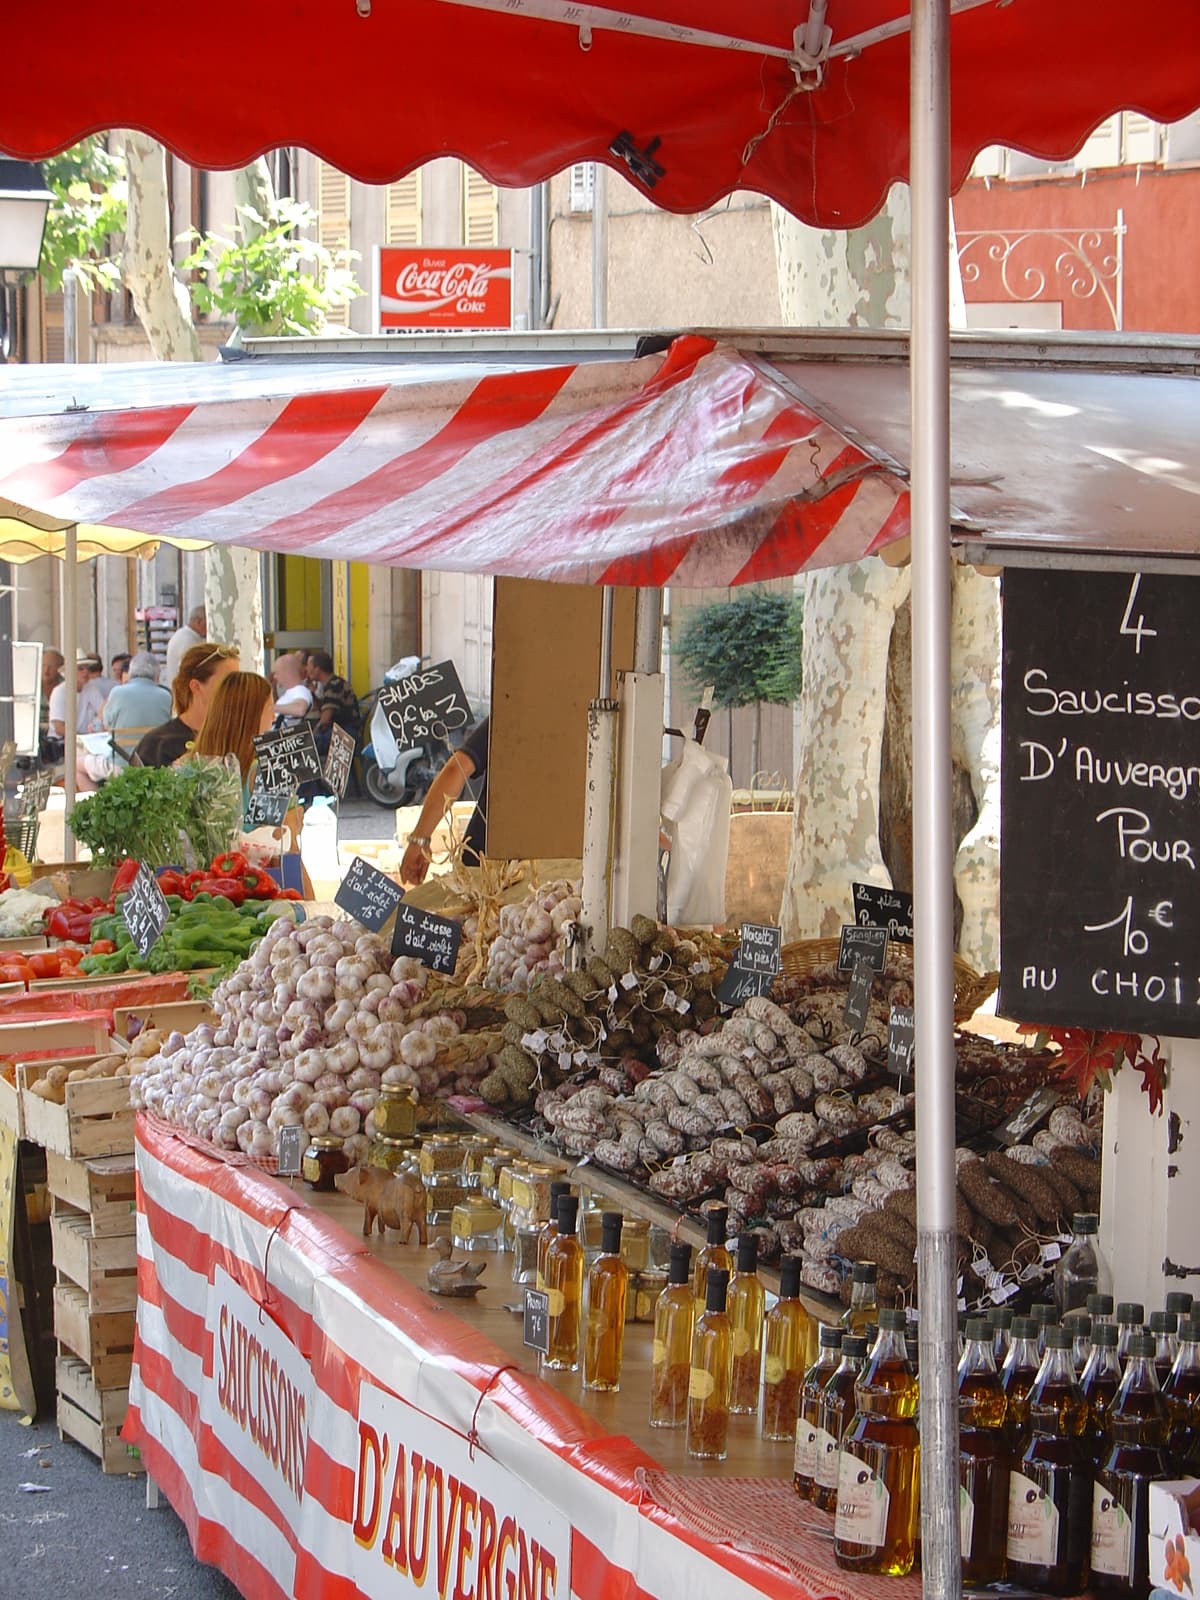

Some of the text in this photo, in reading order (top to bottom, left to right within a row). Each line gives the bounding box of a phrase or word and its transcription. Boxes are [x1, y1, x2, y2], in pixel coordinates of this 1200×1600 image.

[396, 262, 492, 298] Coca-Cola
[456, 297, 486, 313] Coke
[1119, 571, 1158, 655] 4
[378, 669, 444, 706] SALADES
[1023, 965, 1057, 991] AU
[218, 1304, 309, 1505] SAUCISSONS
